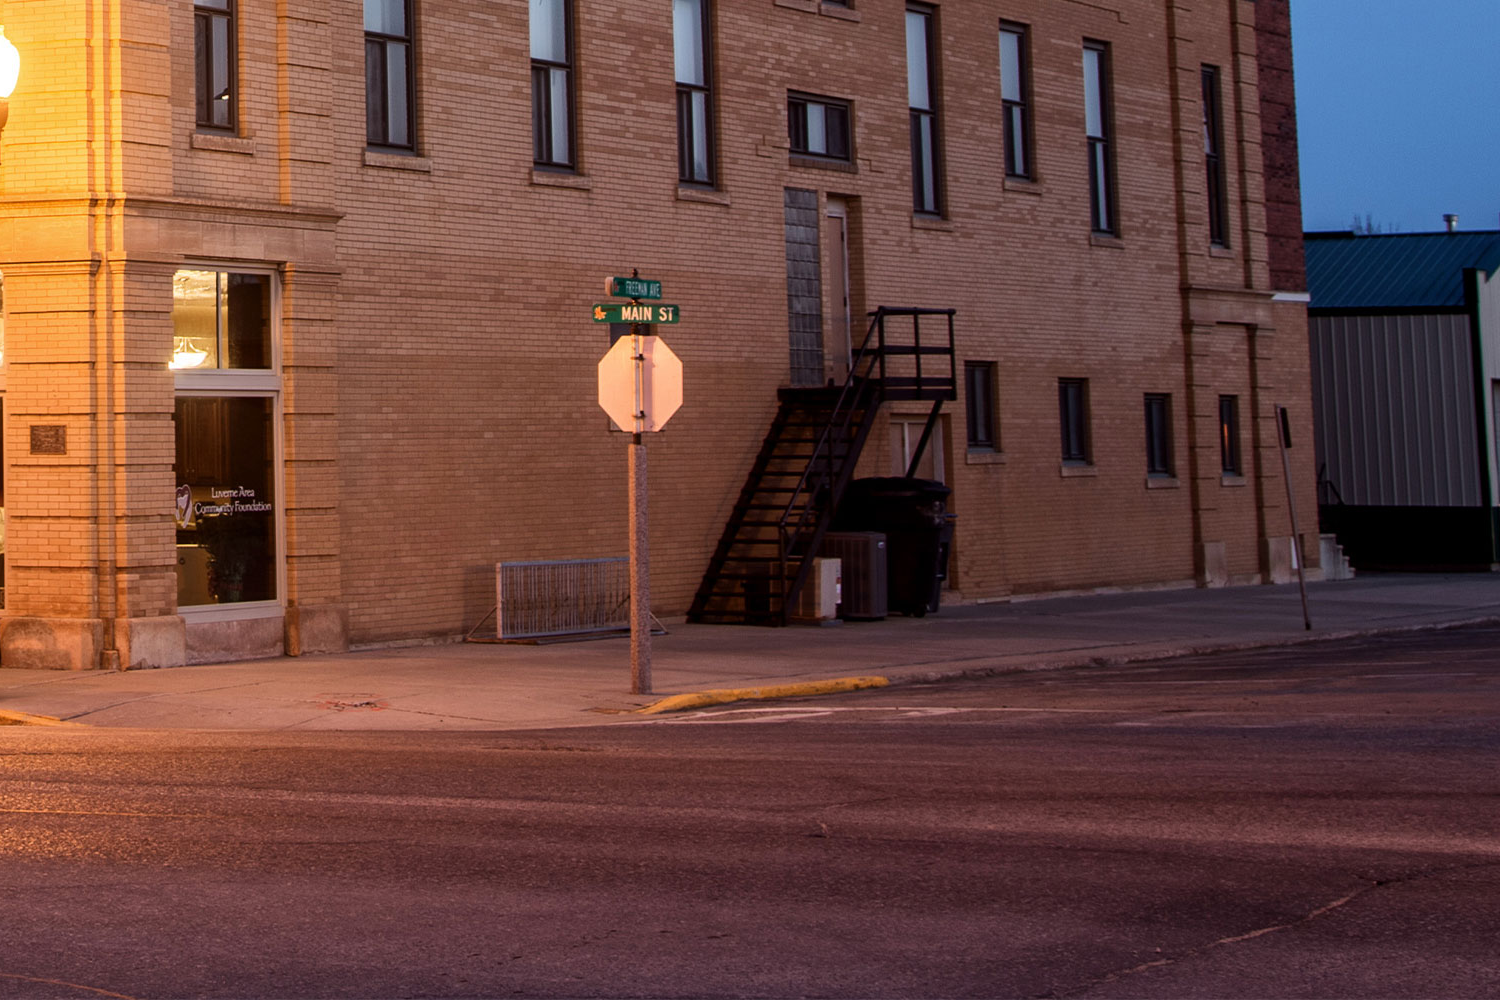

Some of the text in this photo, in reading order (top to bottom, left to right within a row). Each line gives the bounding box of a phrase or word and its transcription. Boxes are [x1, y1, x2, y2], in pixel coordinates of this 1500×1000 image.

[625, 280, 660, 298] FREEMAN AVE
[621, 306, 674, 322] MAIN ST
[211, 486, 255, 498] Luverne Area
[195, 500, 272, 515] Community Foundation
